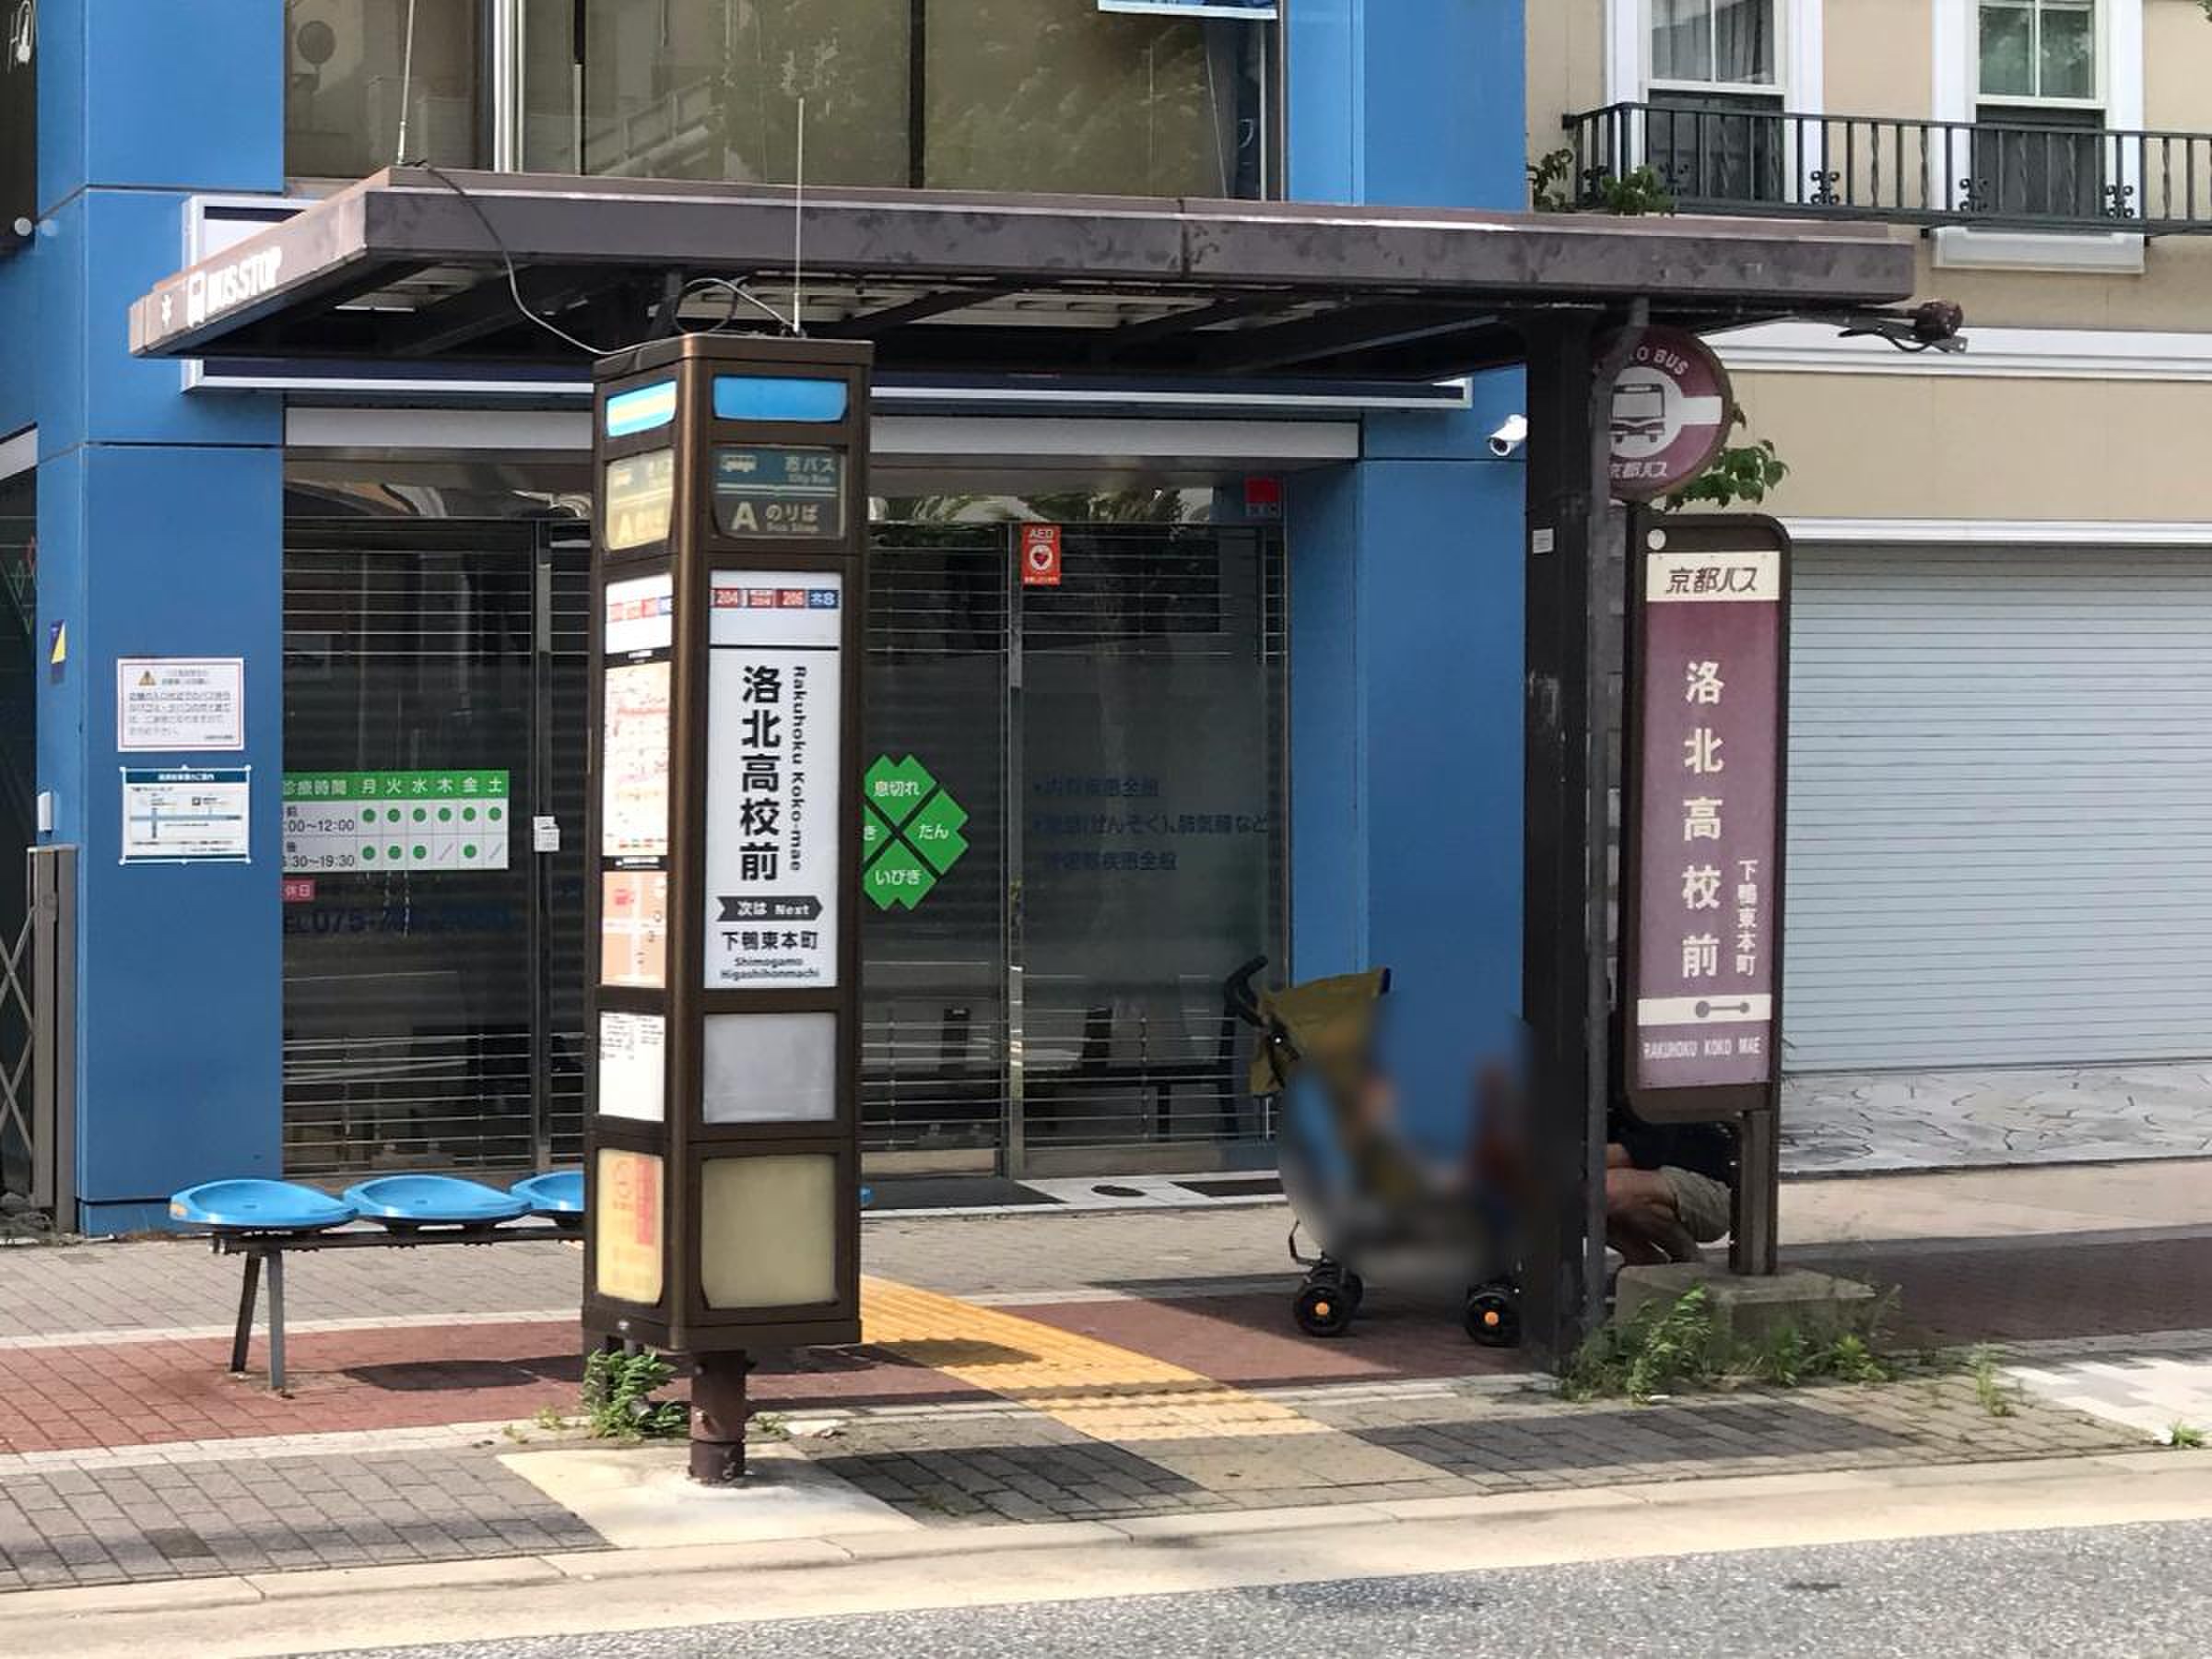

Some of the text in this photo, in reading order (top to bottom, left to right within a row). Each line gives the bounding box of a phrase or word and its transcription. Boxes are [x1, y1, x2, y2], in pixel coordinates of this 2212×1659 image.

[1653, 347, 1688, 375] BUS
[731, 502, 818, 531] A のりば
[1029, 529, 1053, 539] AED
[1665, 566, 1758, 594] 京都バス
[739, 665, 782, 882] 洛北高校前
[790, 665, 807, 872] Rakuhoku Koko-mae
[362, 779, 376, 793] 月
[386, 779, 401, 793] 火
[412, 778, 428, 793] 水
[436, 778, 453, 793] 木
[462, 776, 478, 792] 金
[488, 777, 502, 792] 土
[874, 781, 920, 796] 息切れ
[919, 823, 949, 840] たん
[1681, 660, 1725, 980] 洛北高校前
[875, 869, 921, 886] いびき
[736, 900, 810, 917] 次は Next
[1736, 859, 1759, 977] 下鴨東本町
[721, 931, 818, 951] 下鴨東本町
[1643, 1036, 1761, 1061] RAKUHOKU KOKO MAE
